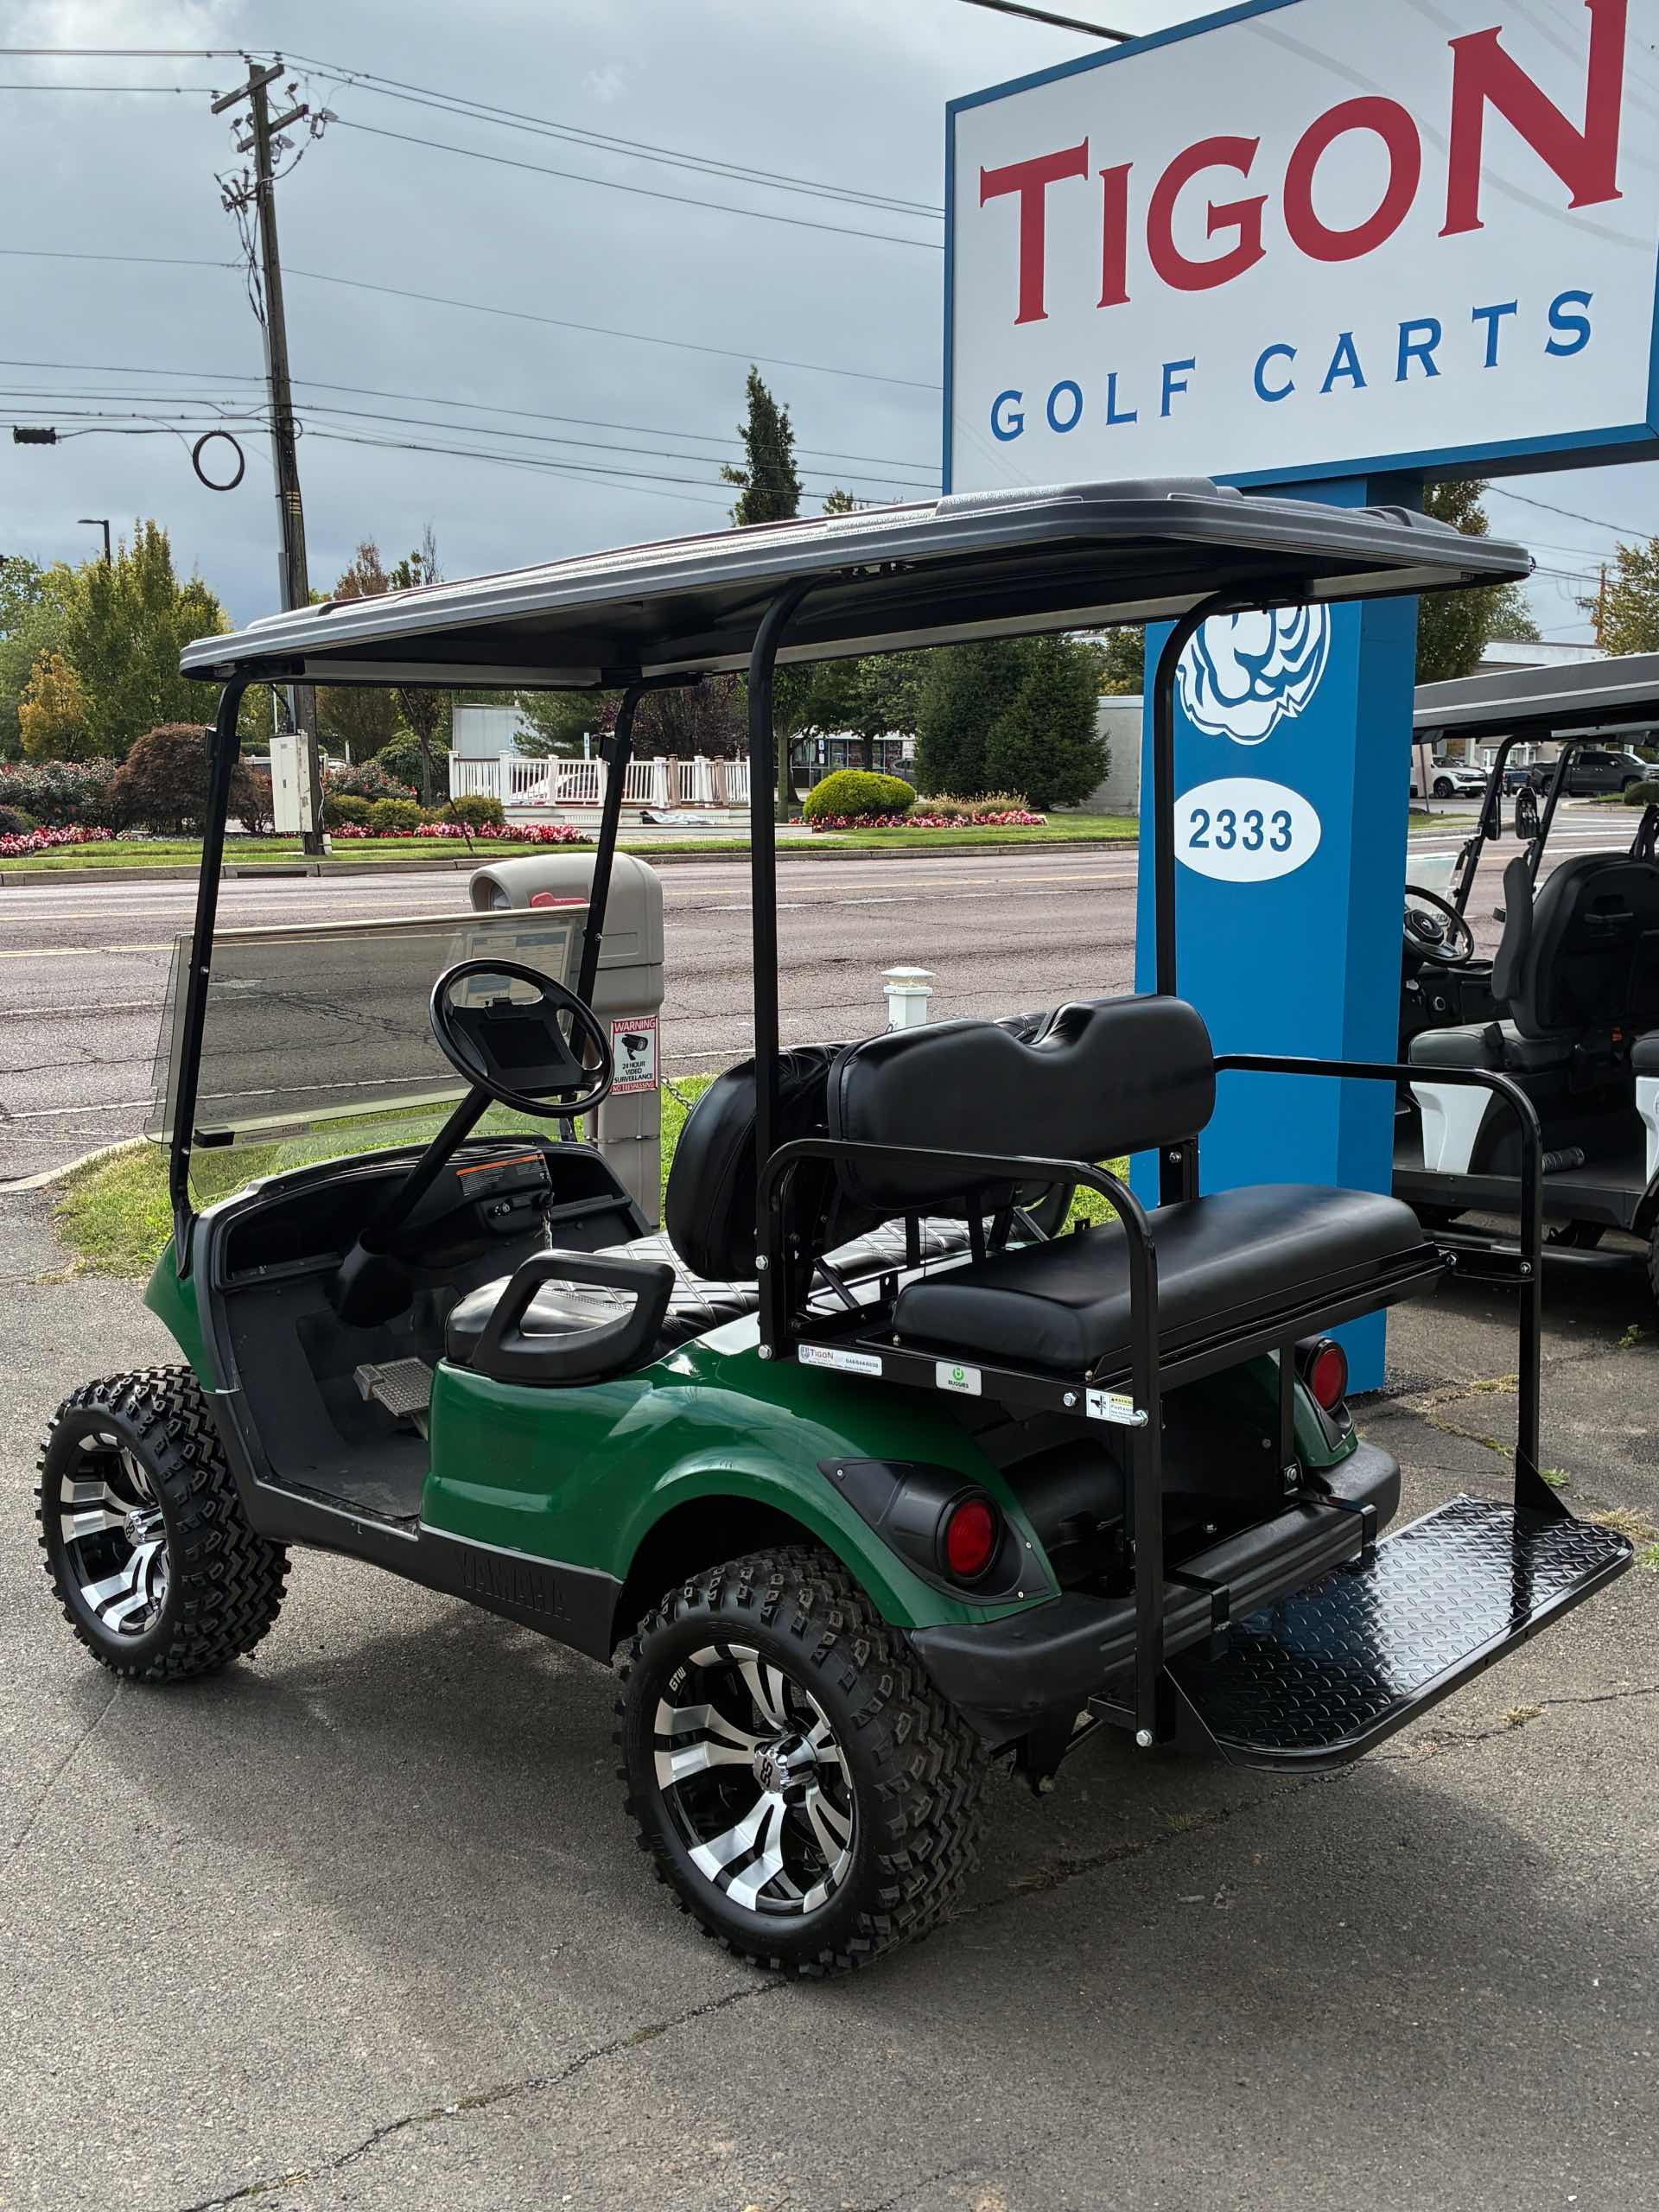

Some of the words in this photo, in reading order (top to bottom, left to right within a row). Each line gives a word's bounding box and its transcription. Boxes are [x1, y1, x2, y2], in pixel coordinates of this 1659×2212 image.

[979, 0, 1628, 325] TIGON
[990, 356, 1197, 442] GOLF
[1253, 289, 1594, 403] CARTS
[1188, 808, 1294, 853] 2333
[613, 1019, 656, 1033] WARNING
[669, 1666, 686, 1692] GTW
